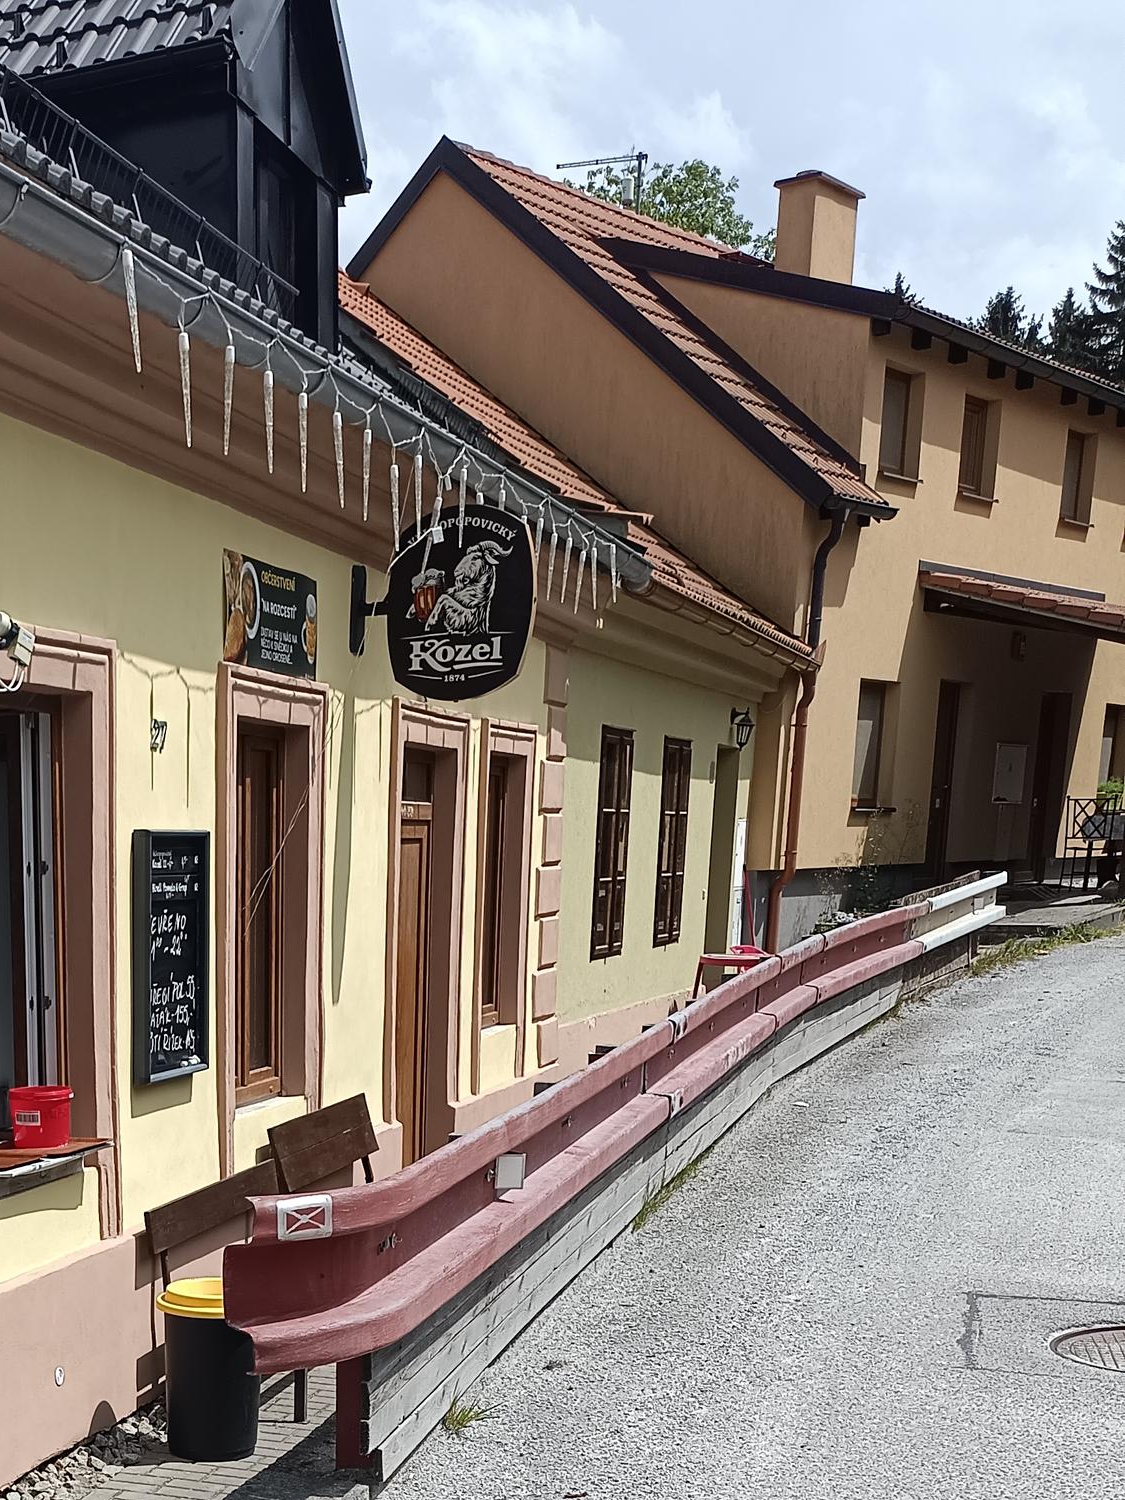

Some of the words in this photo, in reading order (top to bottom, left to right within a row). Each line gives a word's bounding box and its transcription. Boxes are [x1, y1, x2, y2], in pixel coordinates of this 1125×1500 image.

[408, 635, 503, 672] Kozel
[443, 673, 465, 682] 1874
[150, 909, 187, 935] EVŘENO
